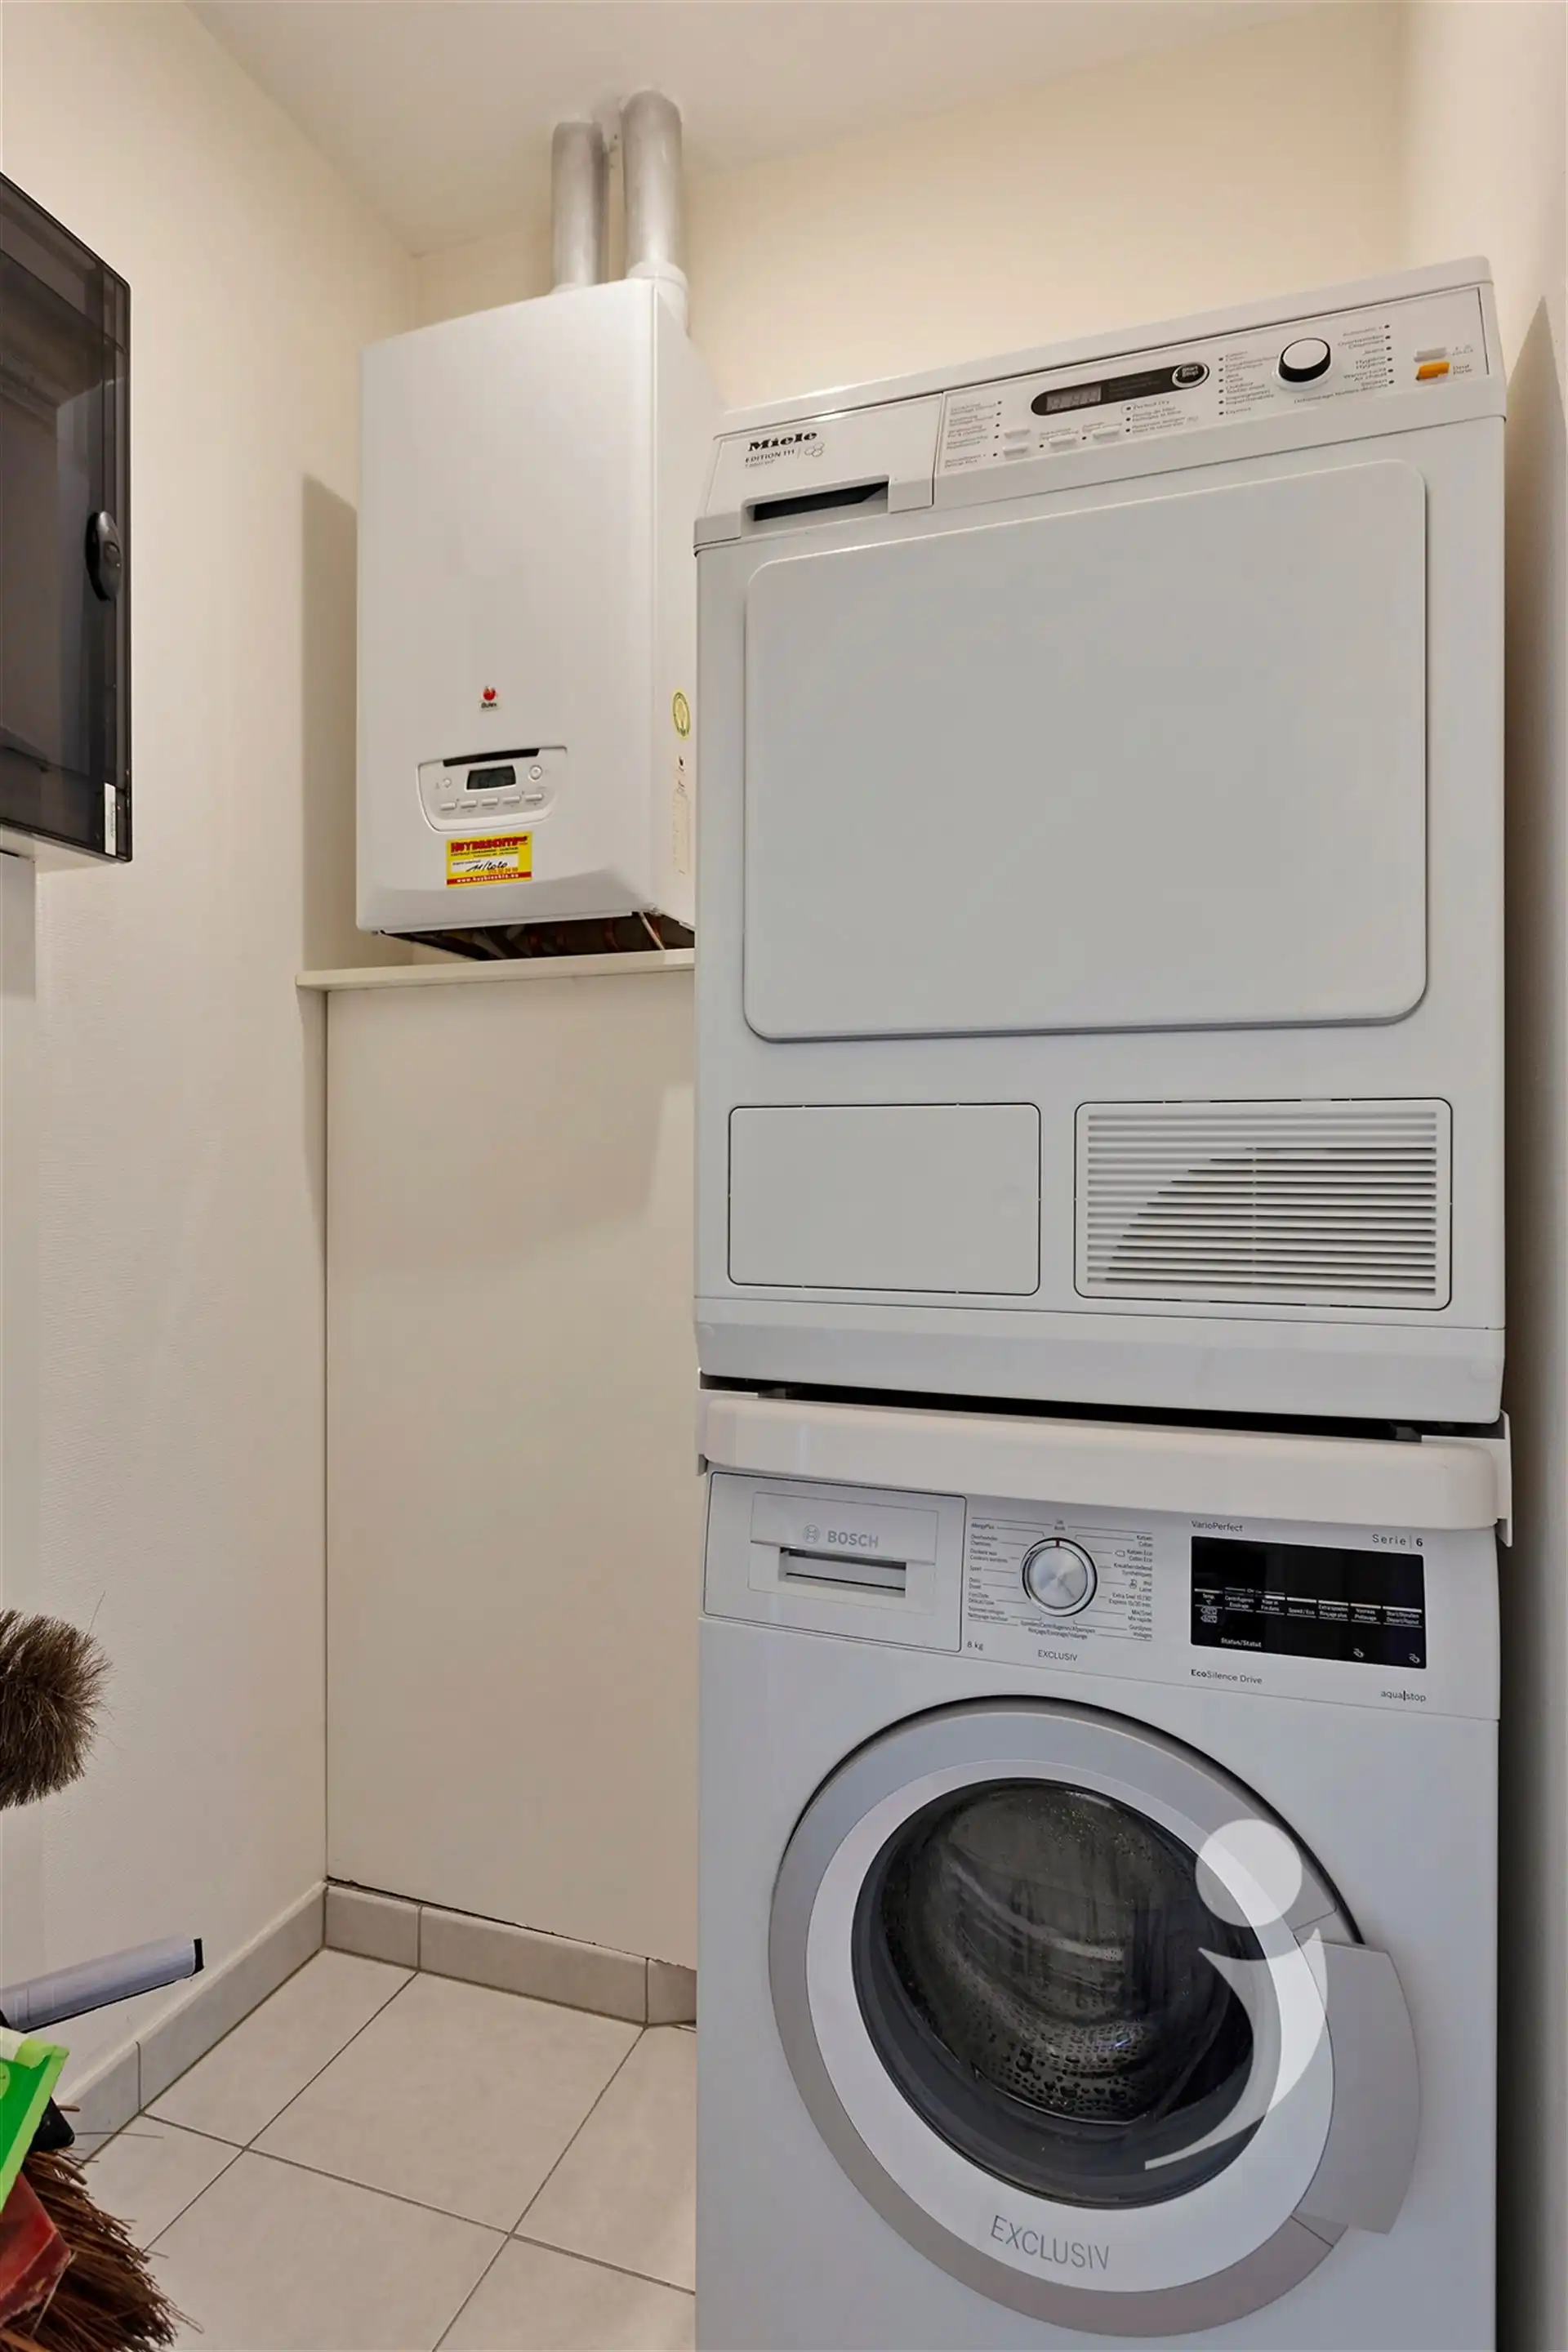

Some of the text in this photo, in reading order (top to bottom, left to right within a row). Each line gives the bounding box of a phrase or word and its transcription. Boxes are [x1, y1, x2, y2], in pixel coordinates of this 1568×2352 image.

[748, 432, 817, 452] Miele
[745, 452, 781, 463] EDITION
[1192, 1520, 1243, 1532] VarioPerfect
[827, 1530, 879, 1548] BOSCH
[1372, 1534, 1423, 1547] Serie 6
[967, 1641, 984, 1651] 8 kg
[1038, 1649, 1078, 1661] EXCLUSIV
[1191, 1668, 1263, 1685] EcoSilence Drive
[991, 2215, 1109, 2270] EXCLUSIV
